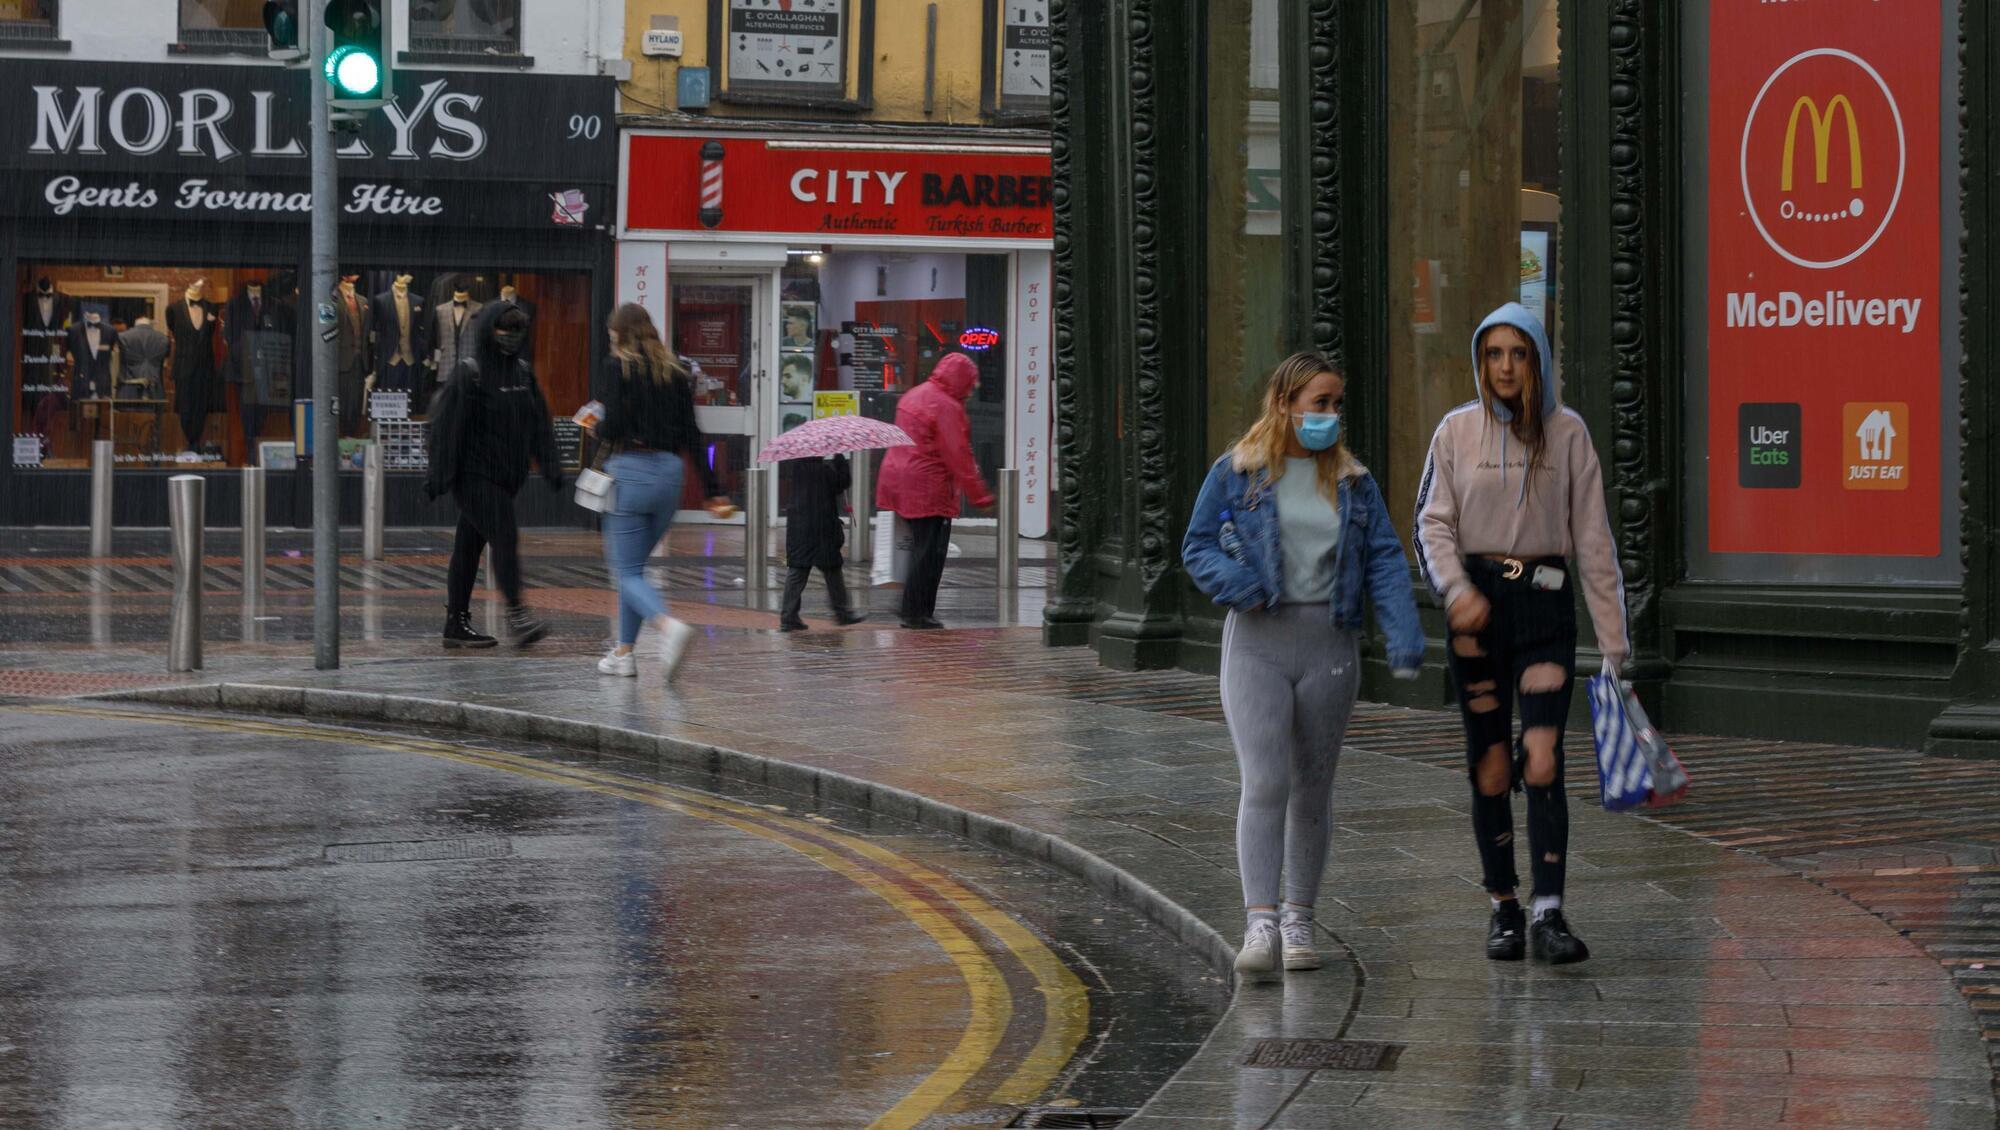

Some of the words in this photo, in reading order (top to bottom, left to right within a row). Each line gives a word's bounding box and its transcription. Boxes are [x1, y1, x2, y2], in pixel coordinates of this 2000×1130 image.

[757, 12, 826, 23] O'CALLAGHAN
[790, 23, 825, 31] SERVICES
[648, 34, 680, 44] HYLAND
[27, 78, 488, 164] MORLYS
[567, 114, 601, 140] 90
[45, 175, 159, 216] Gents
[344, 183, 444, 216] Hire
[790, 168, 908, 205] CITY
[818, 212, 898, 232] Authentic
[927, 214, 985, 236] Turkish
[989, 216, 1048, 235] Barbers
[1726, 290, 1922, 333] McDelivery
[959, 333, 998, 345] OPEN
[1026, 346, 1039, 414] TOWEL
[1750, 426, 1790, 445] Uber
[1750, 447, 1790, 465] Eats
[1848, 465, 1878, 480] JUST
[1880, 465, 1904, 479] EAT
